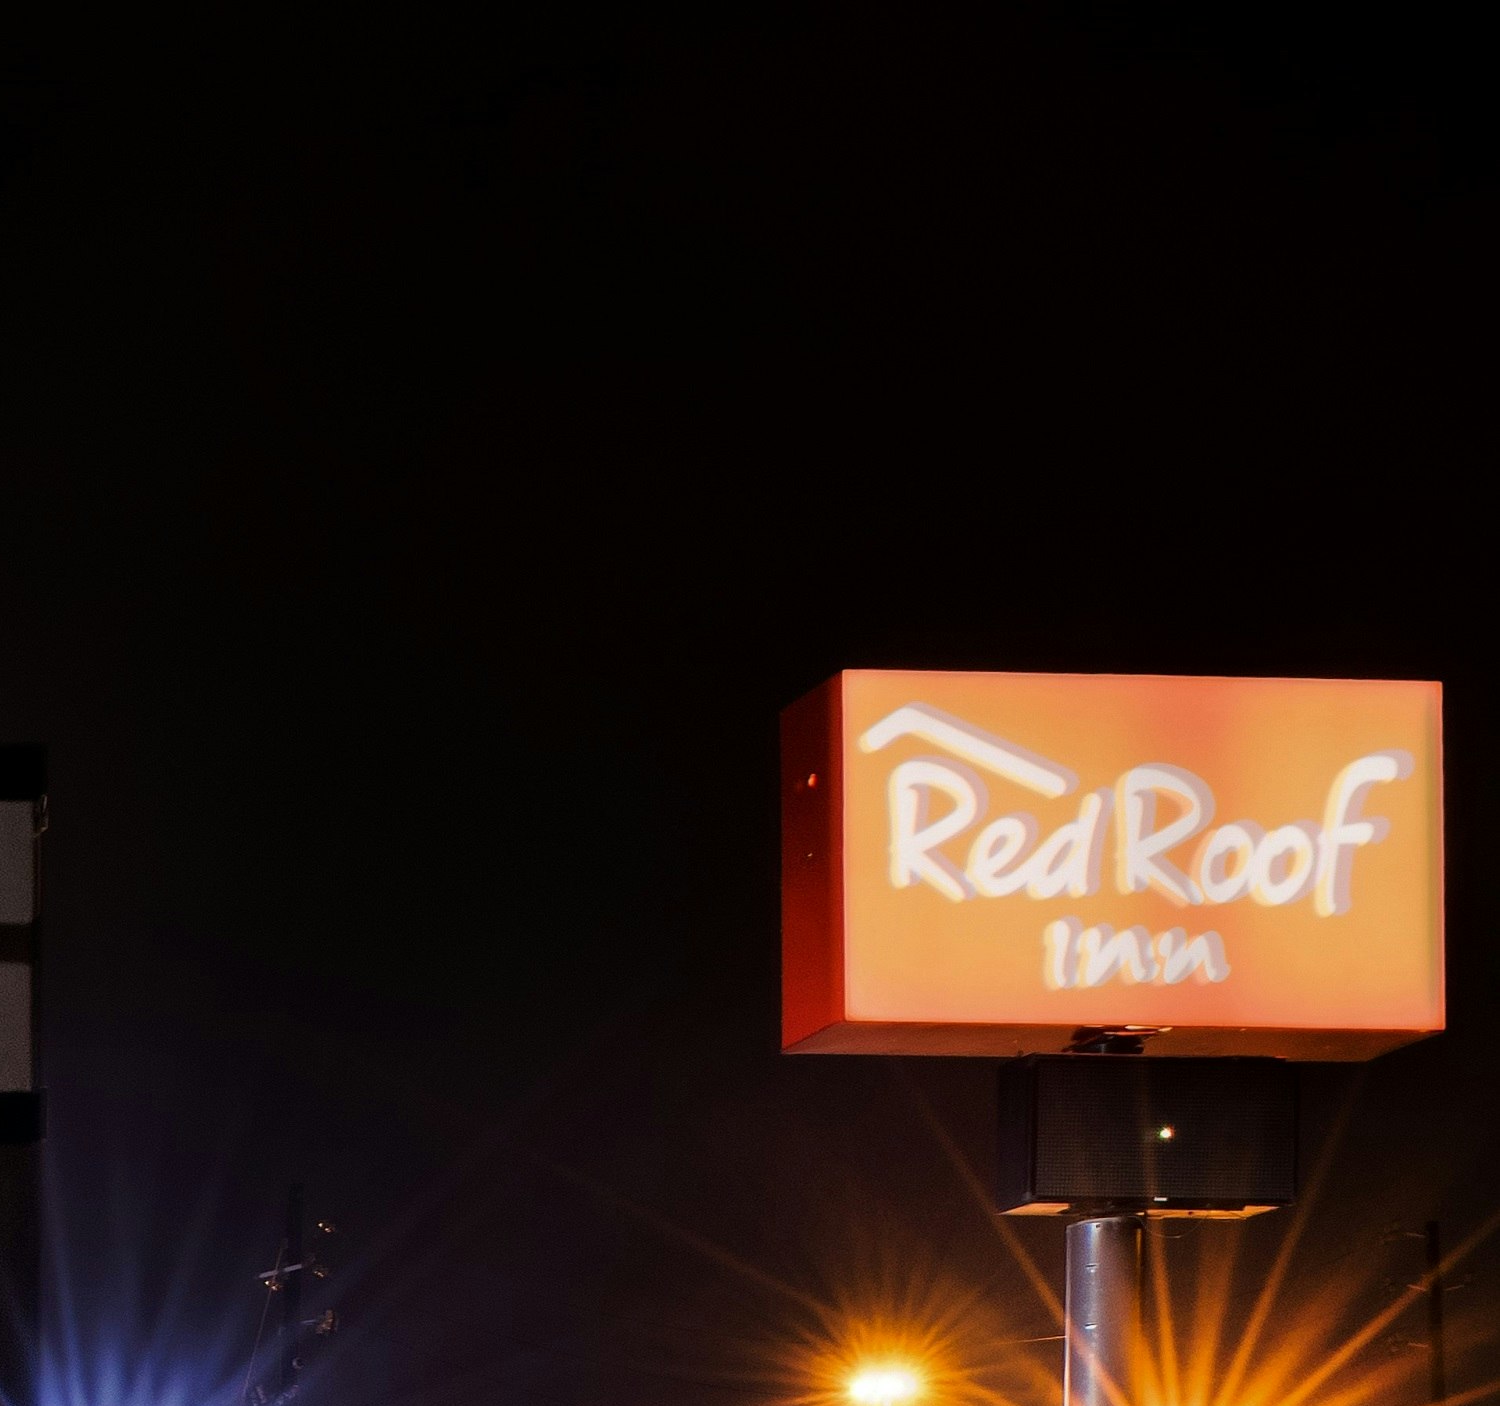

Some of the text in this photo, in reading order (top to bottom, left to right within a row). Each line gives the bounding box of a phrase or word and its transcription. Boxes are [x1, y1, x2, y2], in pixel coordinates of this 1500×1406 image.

[887, 747, 1416, 918] Red Roof
[1043, 916, 1232, 991] Inn
